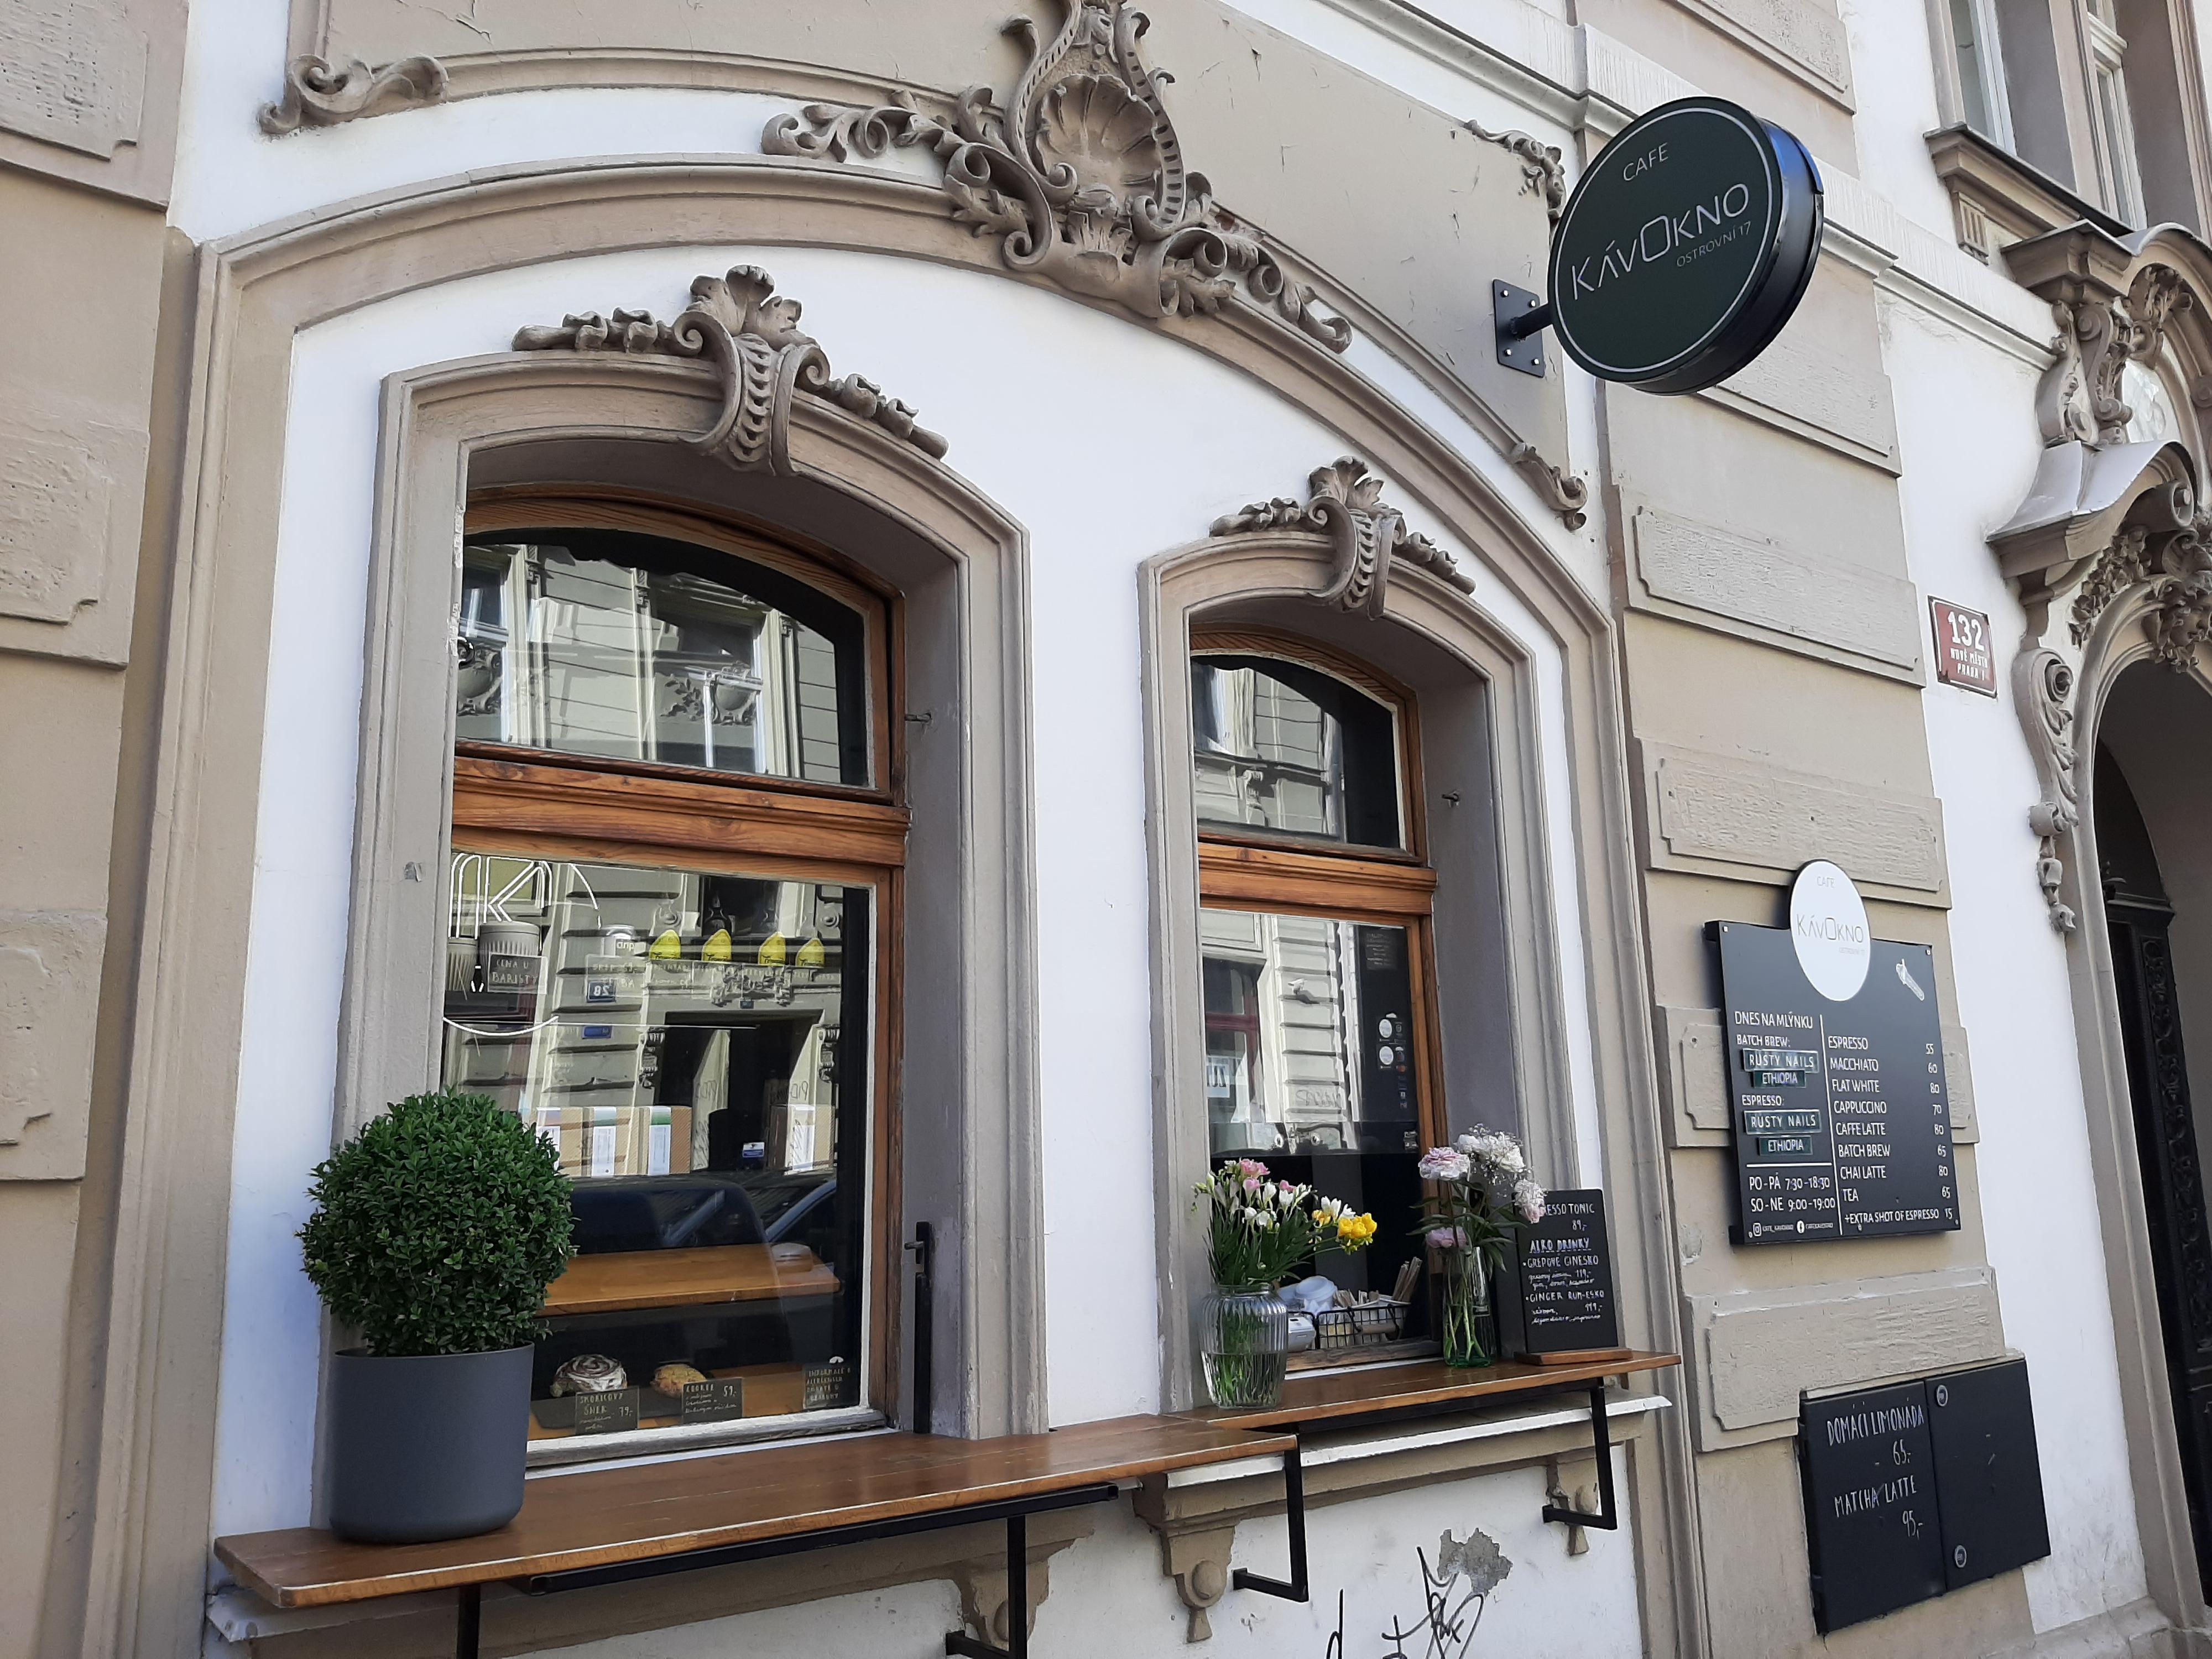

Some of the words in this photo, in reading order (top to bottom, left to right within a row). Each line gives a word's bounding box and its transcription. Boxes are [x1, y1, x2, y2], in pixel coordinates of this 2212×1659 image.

[1622, 141, 1670, 182] CAFE
[1571, 183, 1750, 301] KÁVOKNO
[1676, 225, 1736, 267] OSTROVNÍ
[1738, 220, 1751, 236] 17
[1947, 611, 1985, 651] 132
[1950, 648, 1968, 662] NOVÉ
[1957, 662, 1978, 679] PRAHA
[1796, 914, 1864, 943] KÁVOKNO
[1734, 1011, 1760, 1026] DNES
[1761, 1013, 1775, 1027] NA
[1776, 1011, 1813, 1029] MLÝNKU
[1736, 1034, 1763, 1046] BATCH
[1765, 1036, 1791, 1048] BREW:
[1828, 1035, 1869, 1050] ESPRESSO
[1924, 1043, 1934, 1055] 55
[1749, 1054, 1780, 1067] RUSTY
[1786, 1056, 1814, 1068] NAILS
[1830, 1057, 1879, 1072] MACCHIATO
[1927, 1062, 1938, 1074] 60
[1762, 1072, 1798, 1085] ETHIOPIA
[1832, 1079, 1850, 1092] FLAT
[1851, 1079, 1880, 1093] WHITE
[1929, 1082, 1940, 1094] 80
[1741, 1094, 1785, 1106] ESPRESSO:
[1834, 1100, 1887, 1114] CAPPUCCINO
[1932, 1104, 1942, 1116] 70
[1751, 1115, 1782, 1128] RUSTY
[1788, 1114, 1816, 1127] NAILS
[1835, 1122, 1861, 1136] CAFFE
[1862, 1122, 1886, 1136] LATTE
[1934, 1124, 1944, 1135] 80
[1767, 1139, 1804, 1152] ETHIOPIA
[1838, 1144, 1866, 1158] BATCH
[1867, 1144, 1891, 1157] BREW
[1937, 1144, 1947, 1157] 65
[1840, 1166, 1861, 1180] CHAI
[1863, 1165, 1887, 1179] LATTE
[1938, 1164, 1948, 1177] 80
[1842, 1188, 1859, 1202] TEA
[1942, 1186, 1950, 1199] 65
[1545, 1203, 1567, 1216] ESSO
[1568, 1203, 1595, 1214] TONIC
[1875, 1212, 1893, 1223] SHOT
[1895, 1210, 1905, 1222] OF
[1905, 1208, 1939, 1220] ESPRESSO
[1944, 1208, 1953, 1219] 15
[1557, 1238, 1590, 1251] DRINKY
[1530, 1291, 1563, 1302] GINGER
[1827, 1401, 1869, 1447] DOMÁCÍ
[1870, 1397, 1925, 1436] LIMONÁDA
[1834, 1487, 1880, 1518] MATCHA
[1885, 1475, 1917, 1503] LATTE
